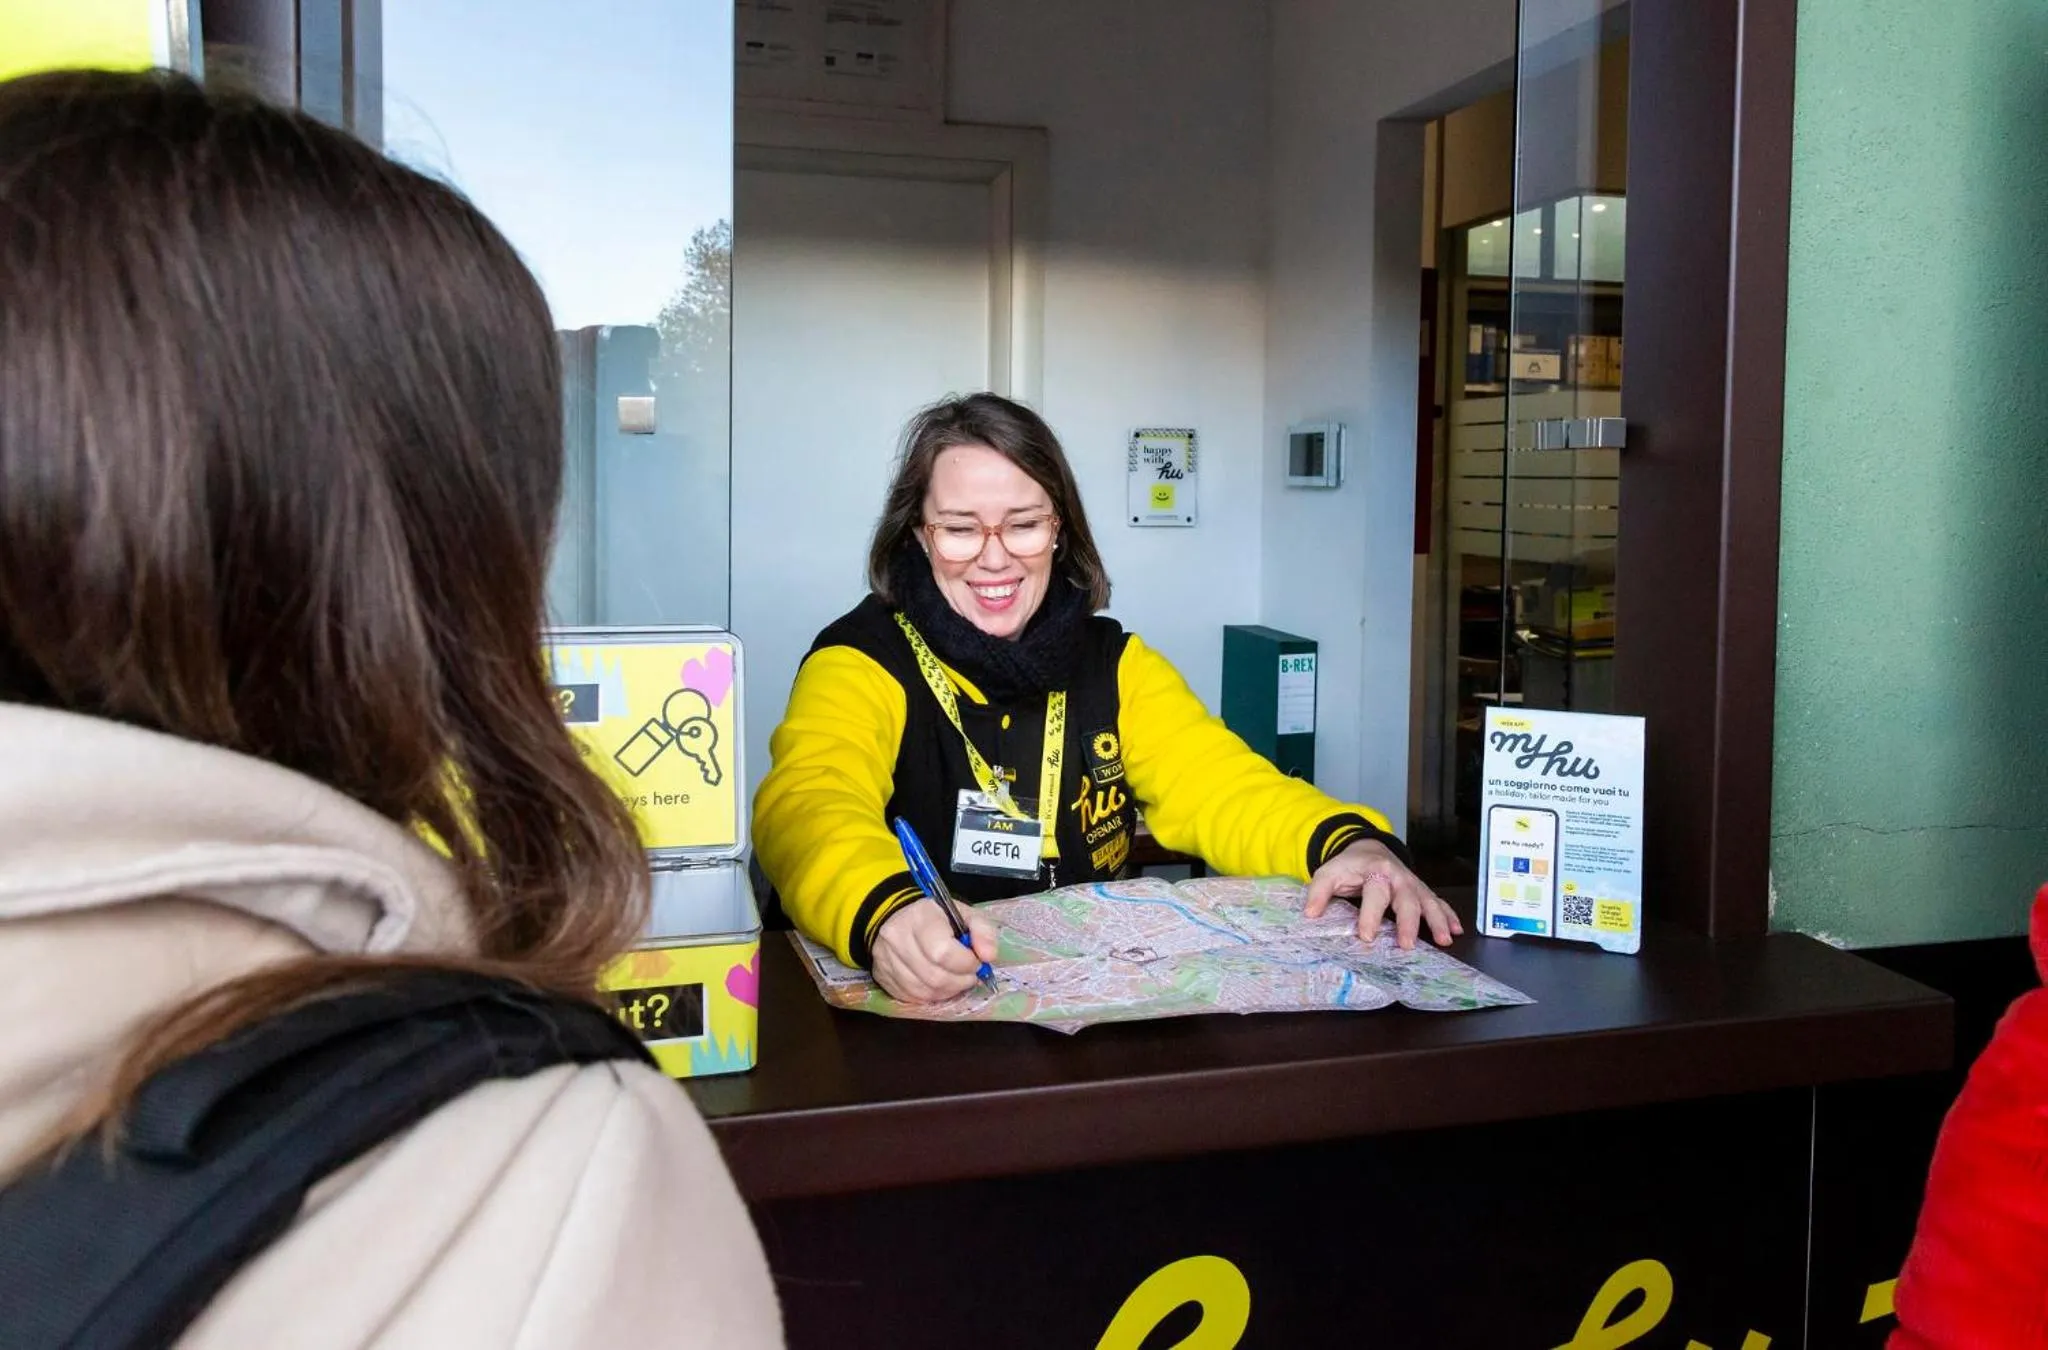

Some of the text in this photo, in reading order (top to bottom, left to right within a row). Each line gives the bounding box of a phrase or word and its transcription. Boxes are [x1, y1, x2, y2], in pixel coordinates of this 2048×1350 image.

[1143, 445, 1173, 456] happy
[1143, 455, 1165, 464] with
[1156, 461, 1184, 480] hu
[1282, 658, 1314, 673] B-REX
[1047, 748, 1061, 768] hu
[1488, 778, 1630, 797] un soggiorno come vuoi tu
[622, 791, 690, 810] eys here
[1071, 774, 1126, 833] hu
[1529, 791, 1551, 800] tailor
[1552, 793, 1576, 803] made
[1577, 795, 1591, 803] for
[1592, 797, 1610, 806] you
[987, 819, 1014, 831] I AM
[971, 840, 1020, 860] GRETA
